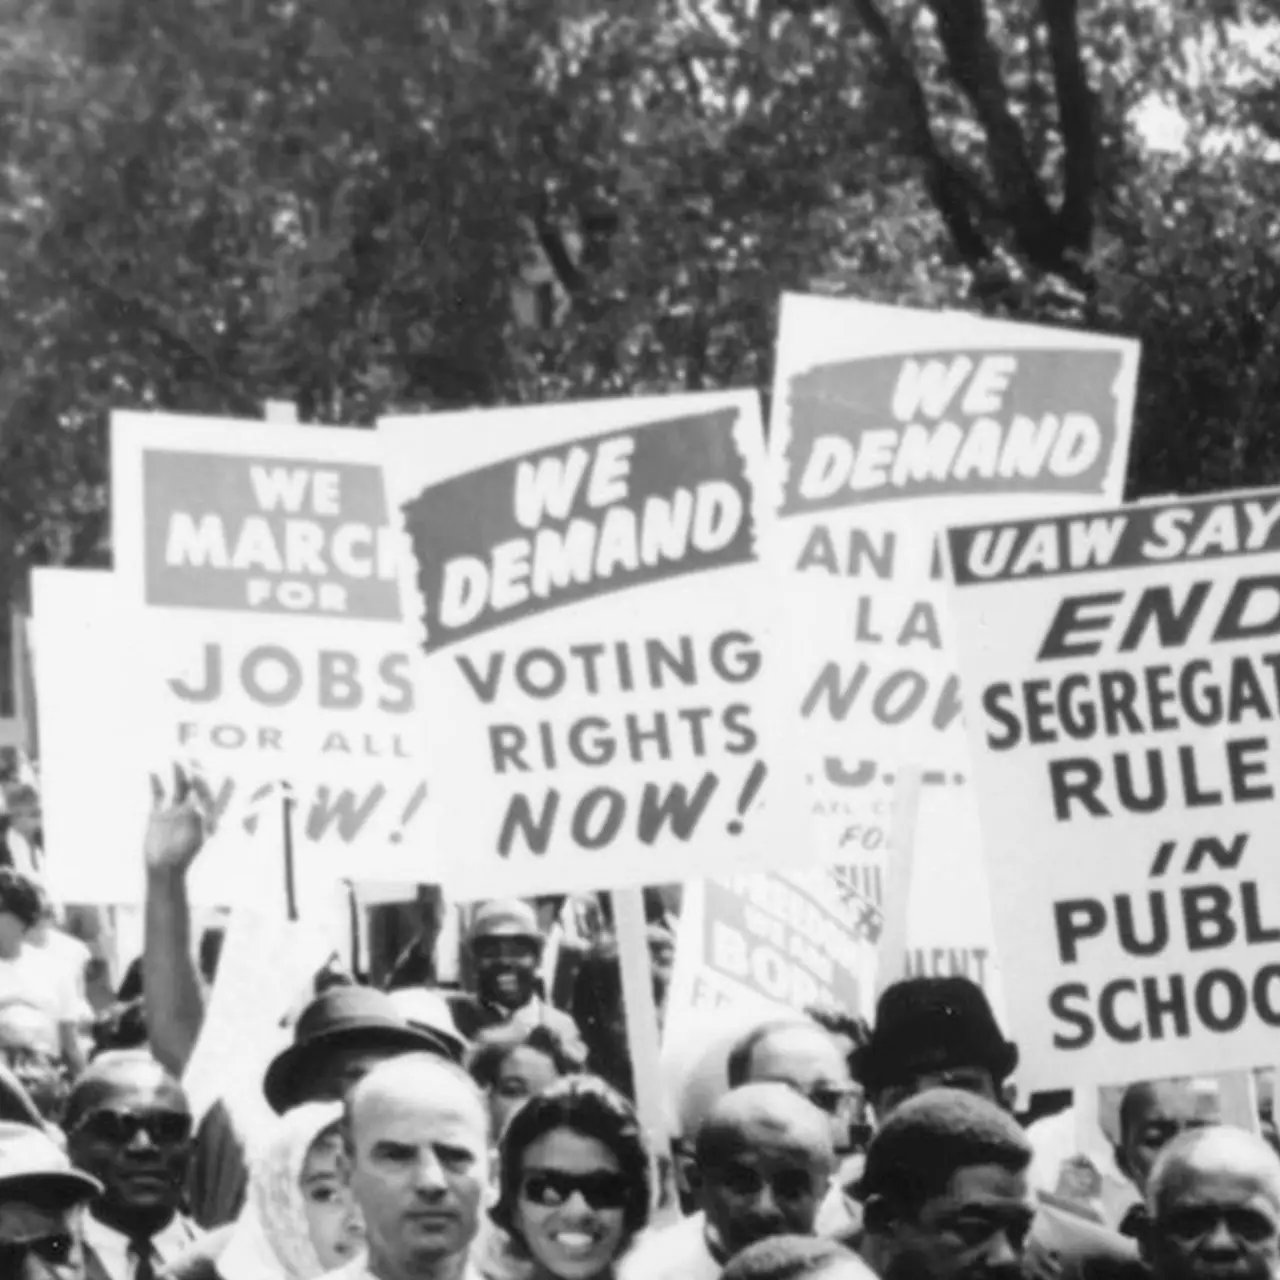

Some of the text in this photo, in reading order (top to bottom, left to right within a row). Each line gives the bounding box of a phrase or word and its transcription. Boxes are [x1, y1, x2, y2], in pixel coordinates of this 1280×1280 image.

[891, 356, 1017, 422] WE
[513, 437, 635, 528] WE
[799, 413, 1101, 498] DEMAND
[250, 466, 340, 515] WE
[437, 481, 743, 628] DEMAND
[797, 525, 895, 580] AN
[965, 516, 1128, 579] UAW
[247, 579, 347, 612] FOR
[167, 642, 415, 714] JOBS
[455, 631, 763, 703] VOTING
[177, 720, 412, 759] FOR ALL
[488, 703, 759, 774] RIGHTS
[497, 760, 767, 857] NOW!
[1148, 833, 1250, 877] IN
